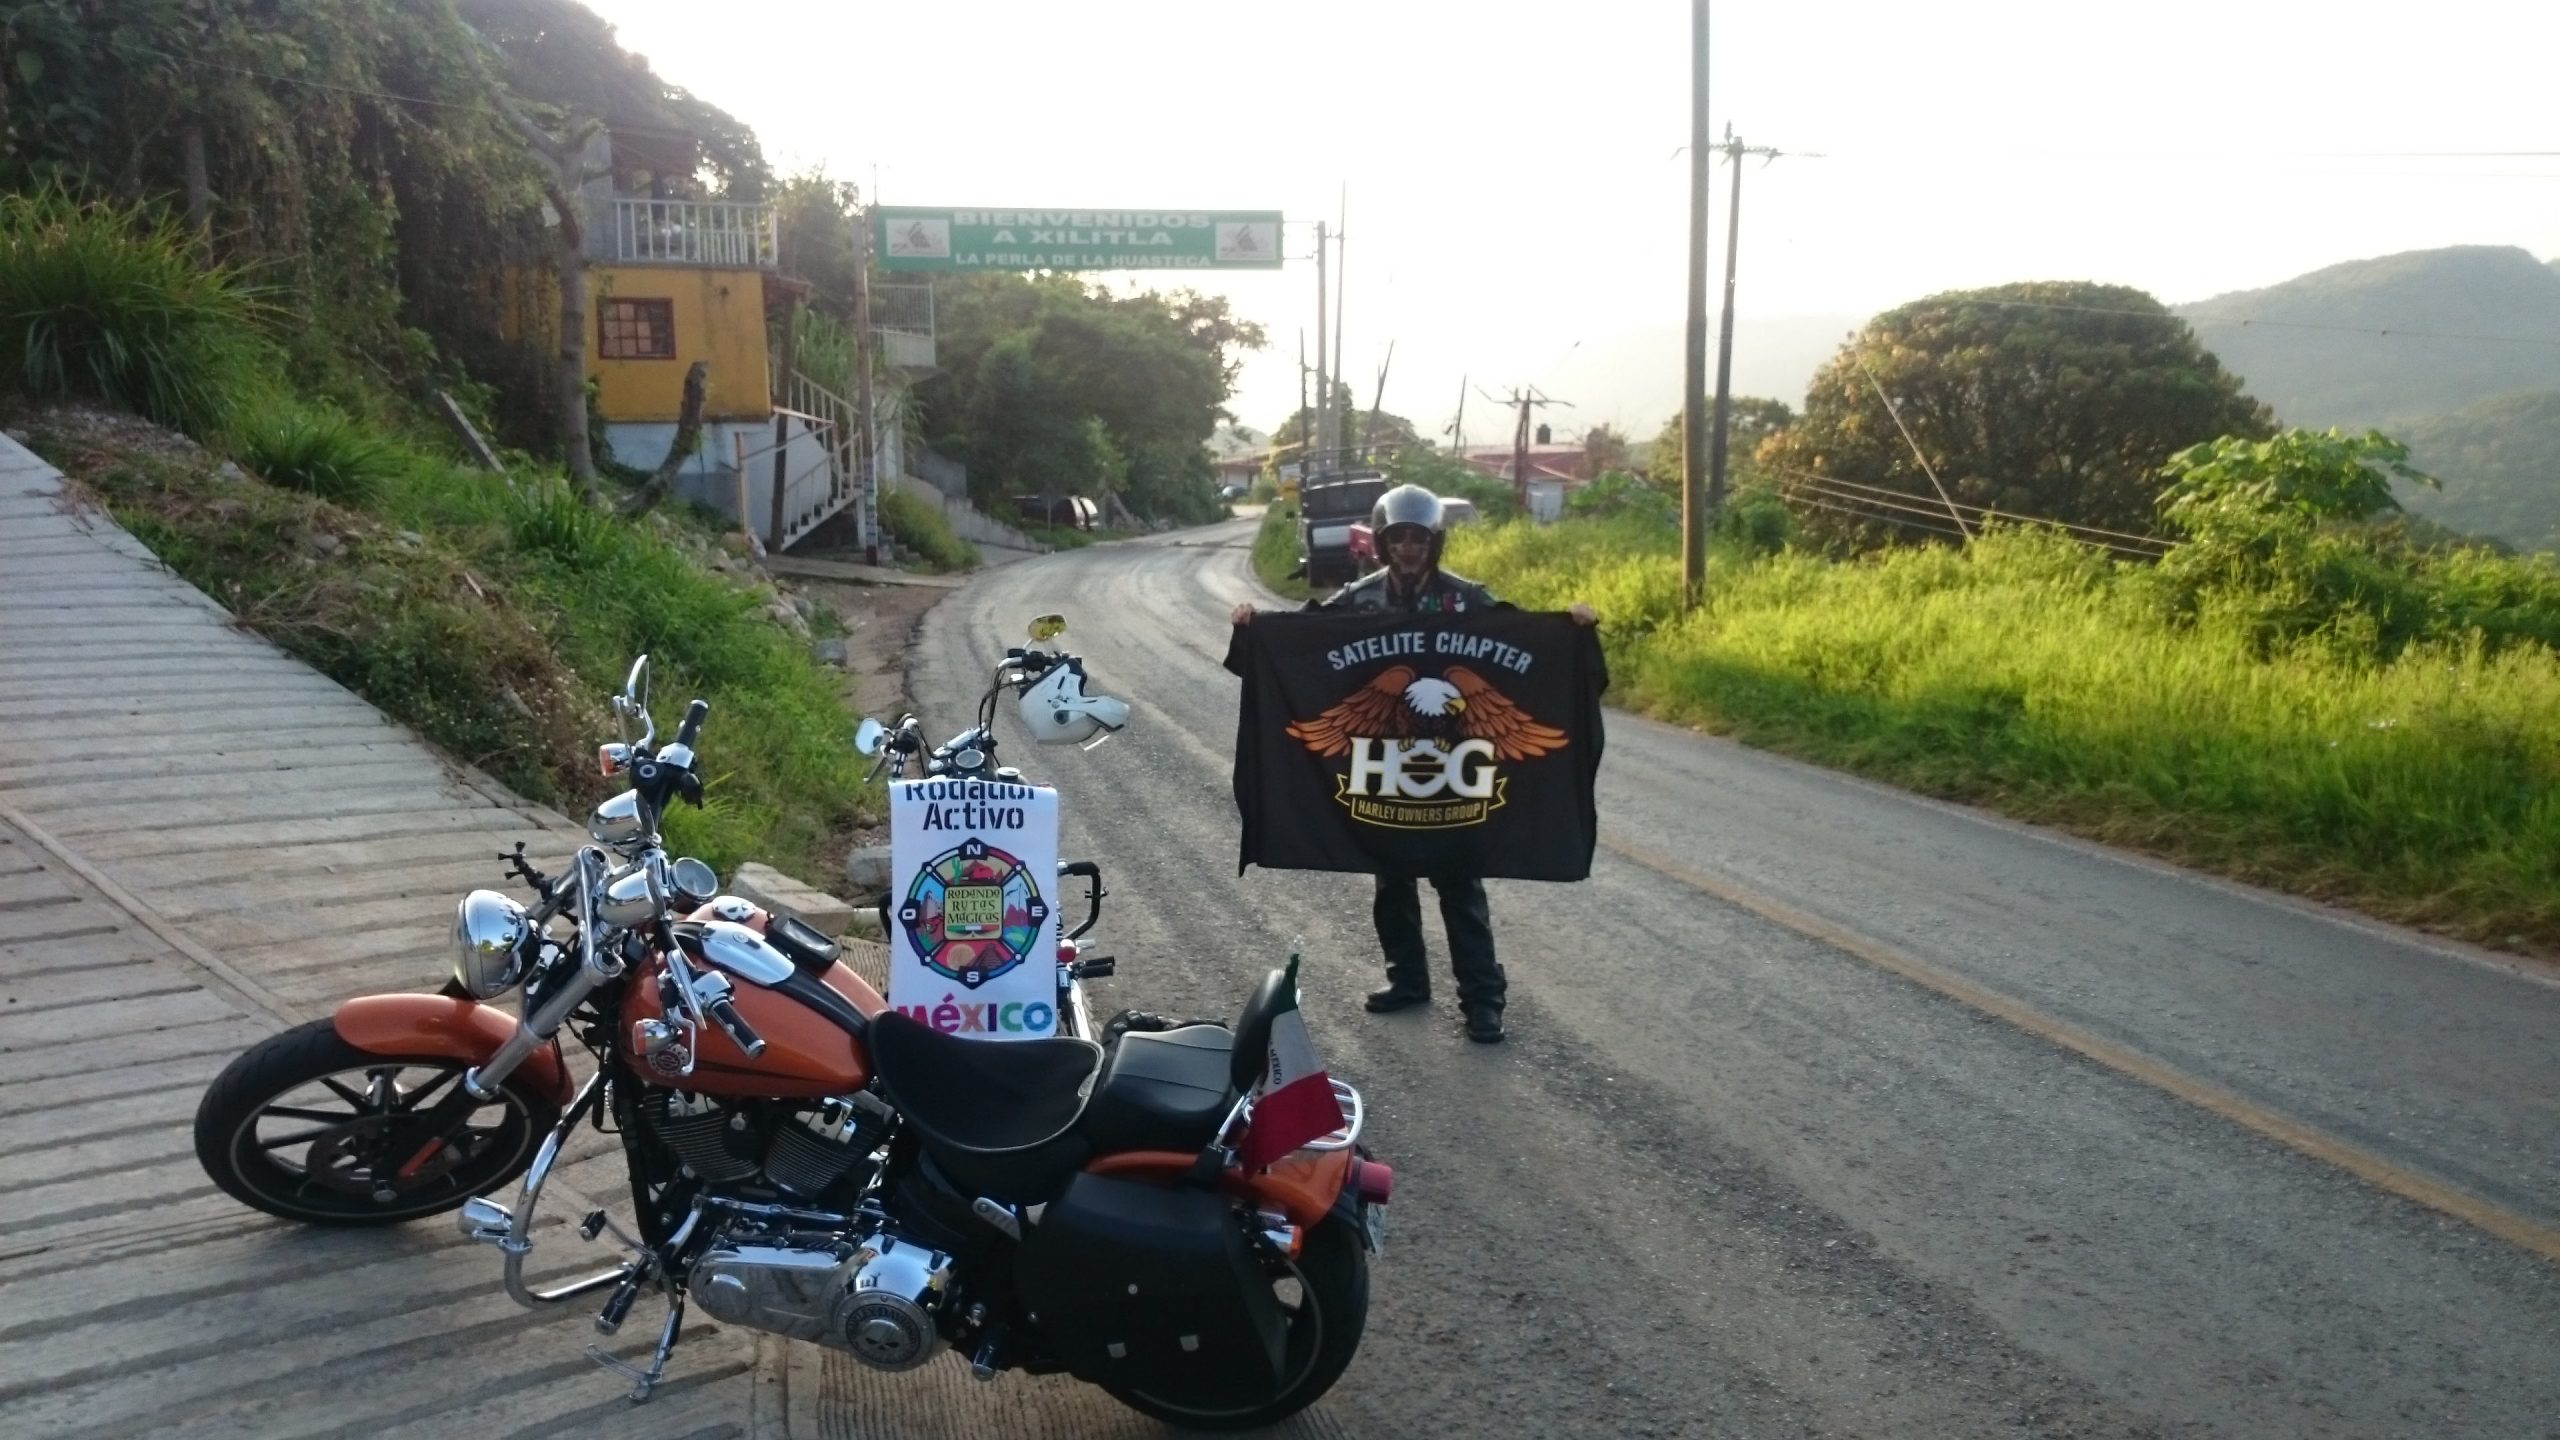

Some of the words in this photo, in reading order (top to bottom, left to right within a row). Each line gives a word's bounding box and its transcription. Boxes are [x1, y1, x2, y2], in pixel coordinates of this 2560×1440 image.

[953, 211, 1211, 229] BIENVENIDOS
[992, 230, 1017, 244] A
[1030, 230, 1174, 245] XILITLA
[955, 252, 979, 265] LA
[985, 253, 1045, 266] PERLA
[1052, 253, 1076, 266] DE
[1082, 254, 1105, 267] LA
[1111, 255, 1211, 268] HUASTECA
[1327, 631, 1425, 671] SATELITE
[1435, 631, 1533, 675] CHAPTER
[1346, 736, 1498, 799] HOG
[922, 801, 1024, 831] Activo
[1358, 799, 1396, 820] HARLEY
[1397, 806, 1442, 822] OWNERS
[1444, 802, 1481, 820] GROUP
[966, 844, 982, 855] N
[902, 909, 917, 920] O
[1031, 905, 1043, 917] E
[966, 971, 980, 983] S
